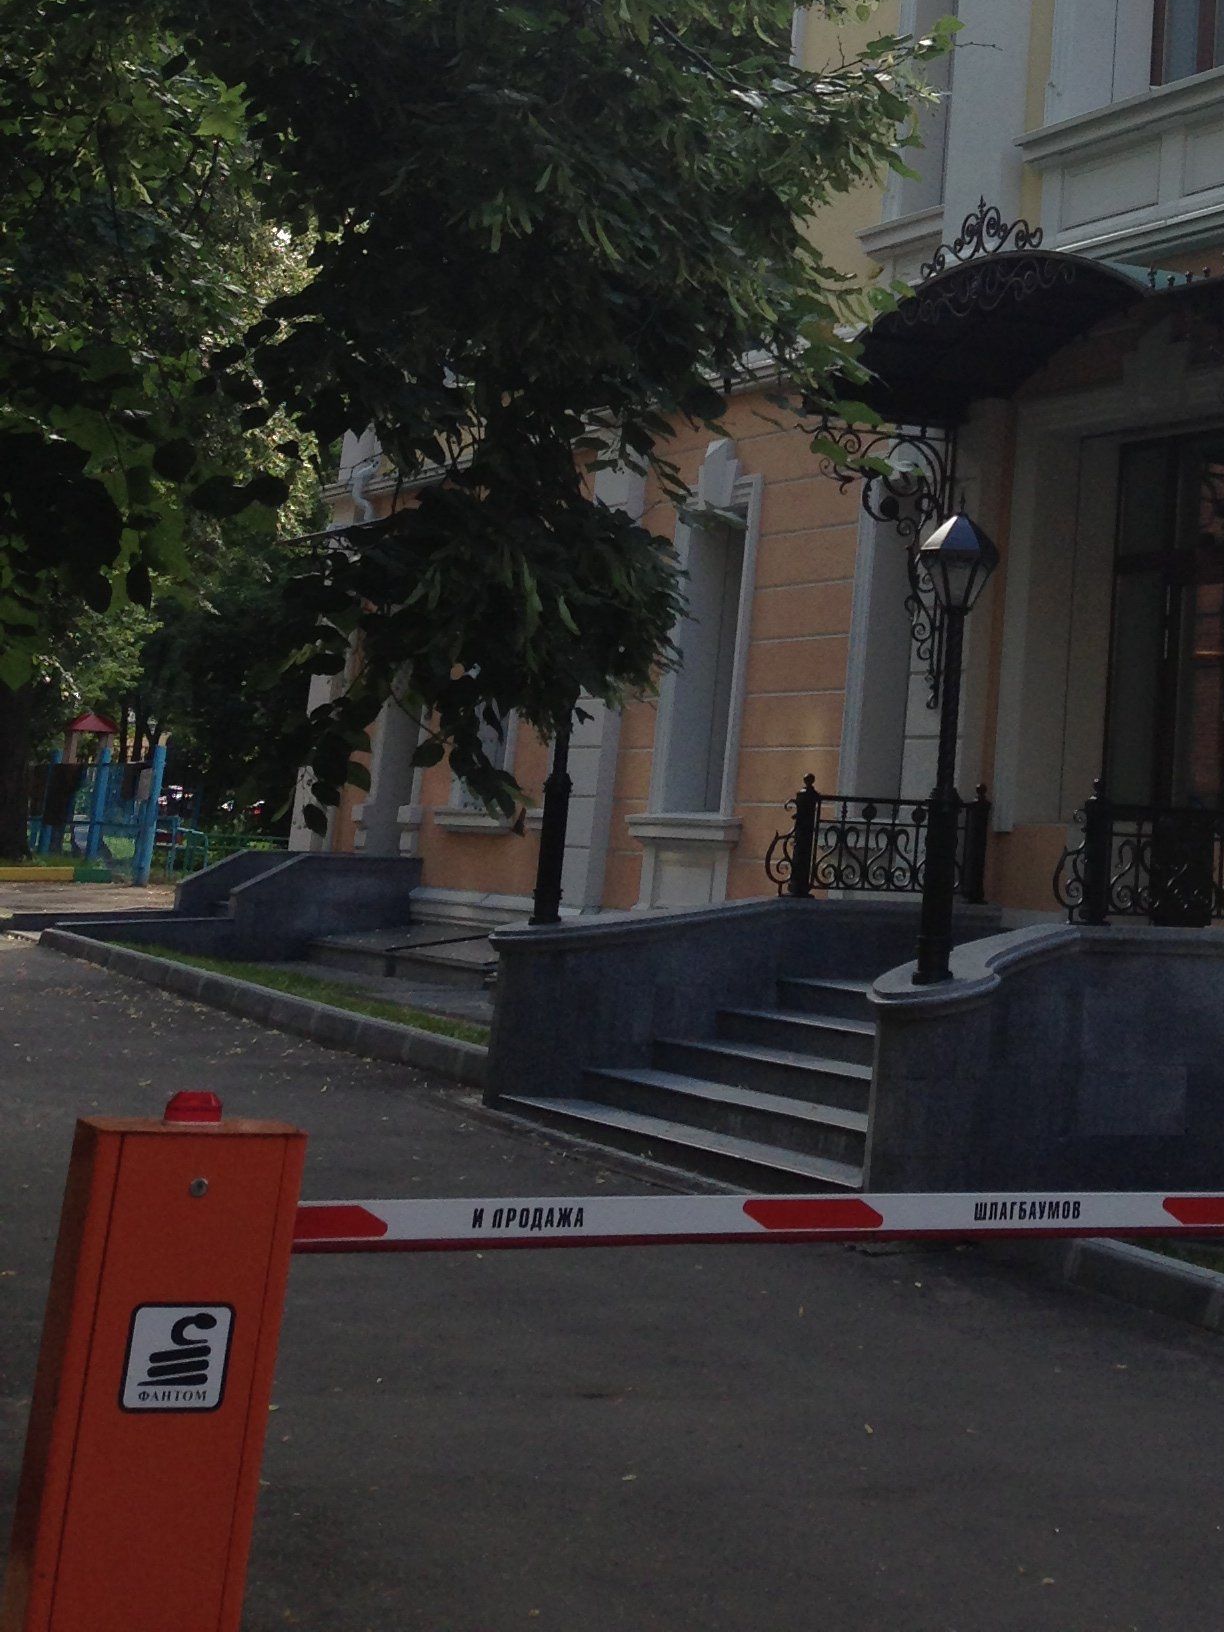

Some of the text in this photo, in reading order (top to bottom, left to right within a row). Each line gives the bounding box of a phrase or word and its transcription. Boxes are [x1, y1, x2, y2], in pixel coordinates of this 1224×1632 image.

[472, 1208, 484, 1228] И
[492, 1207, 584, 1231] ПРОДАЖА
[974, 1201, 1081, 1221] ШЛАГБАУМОВ
[138, 1390, 208, 1402] ФАНТОМ
